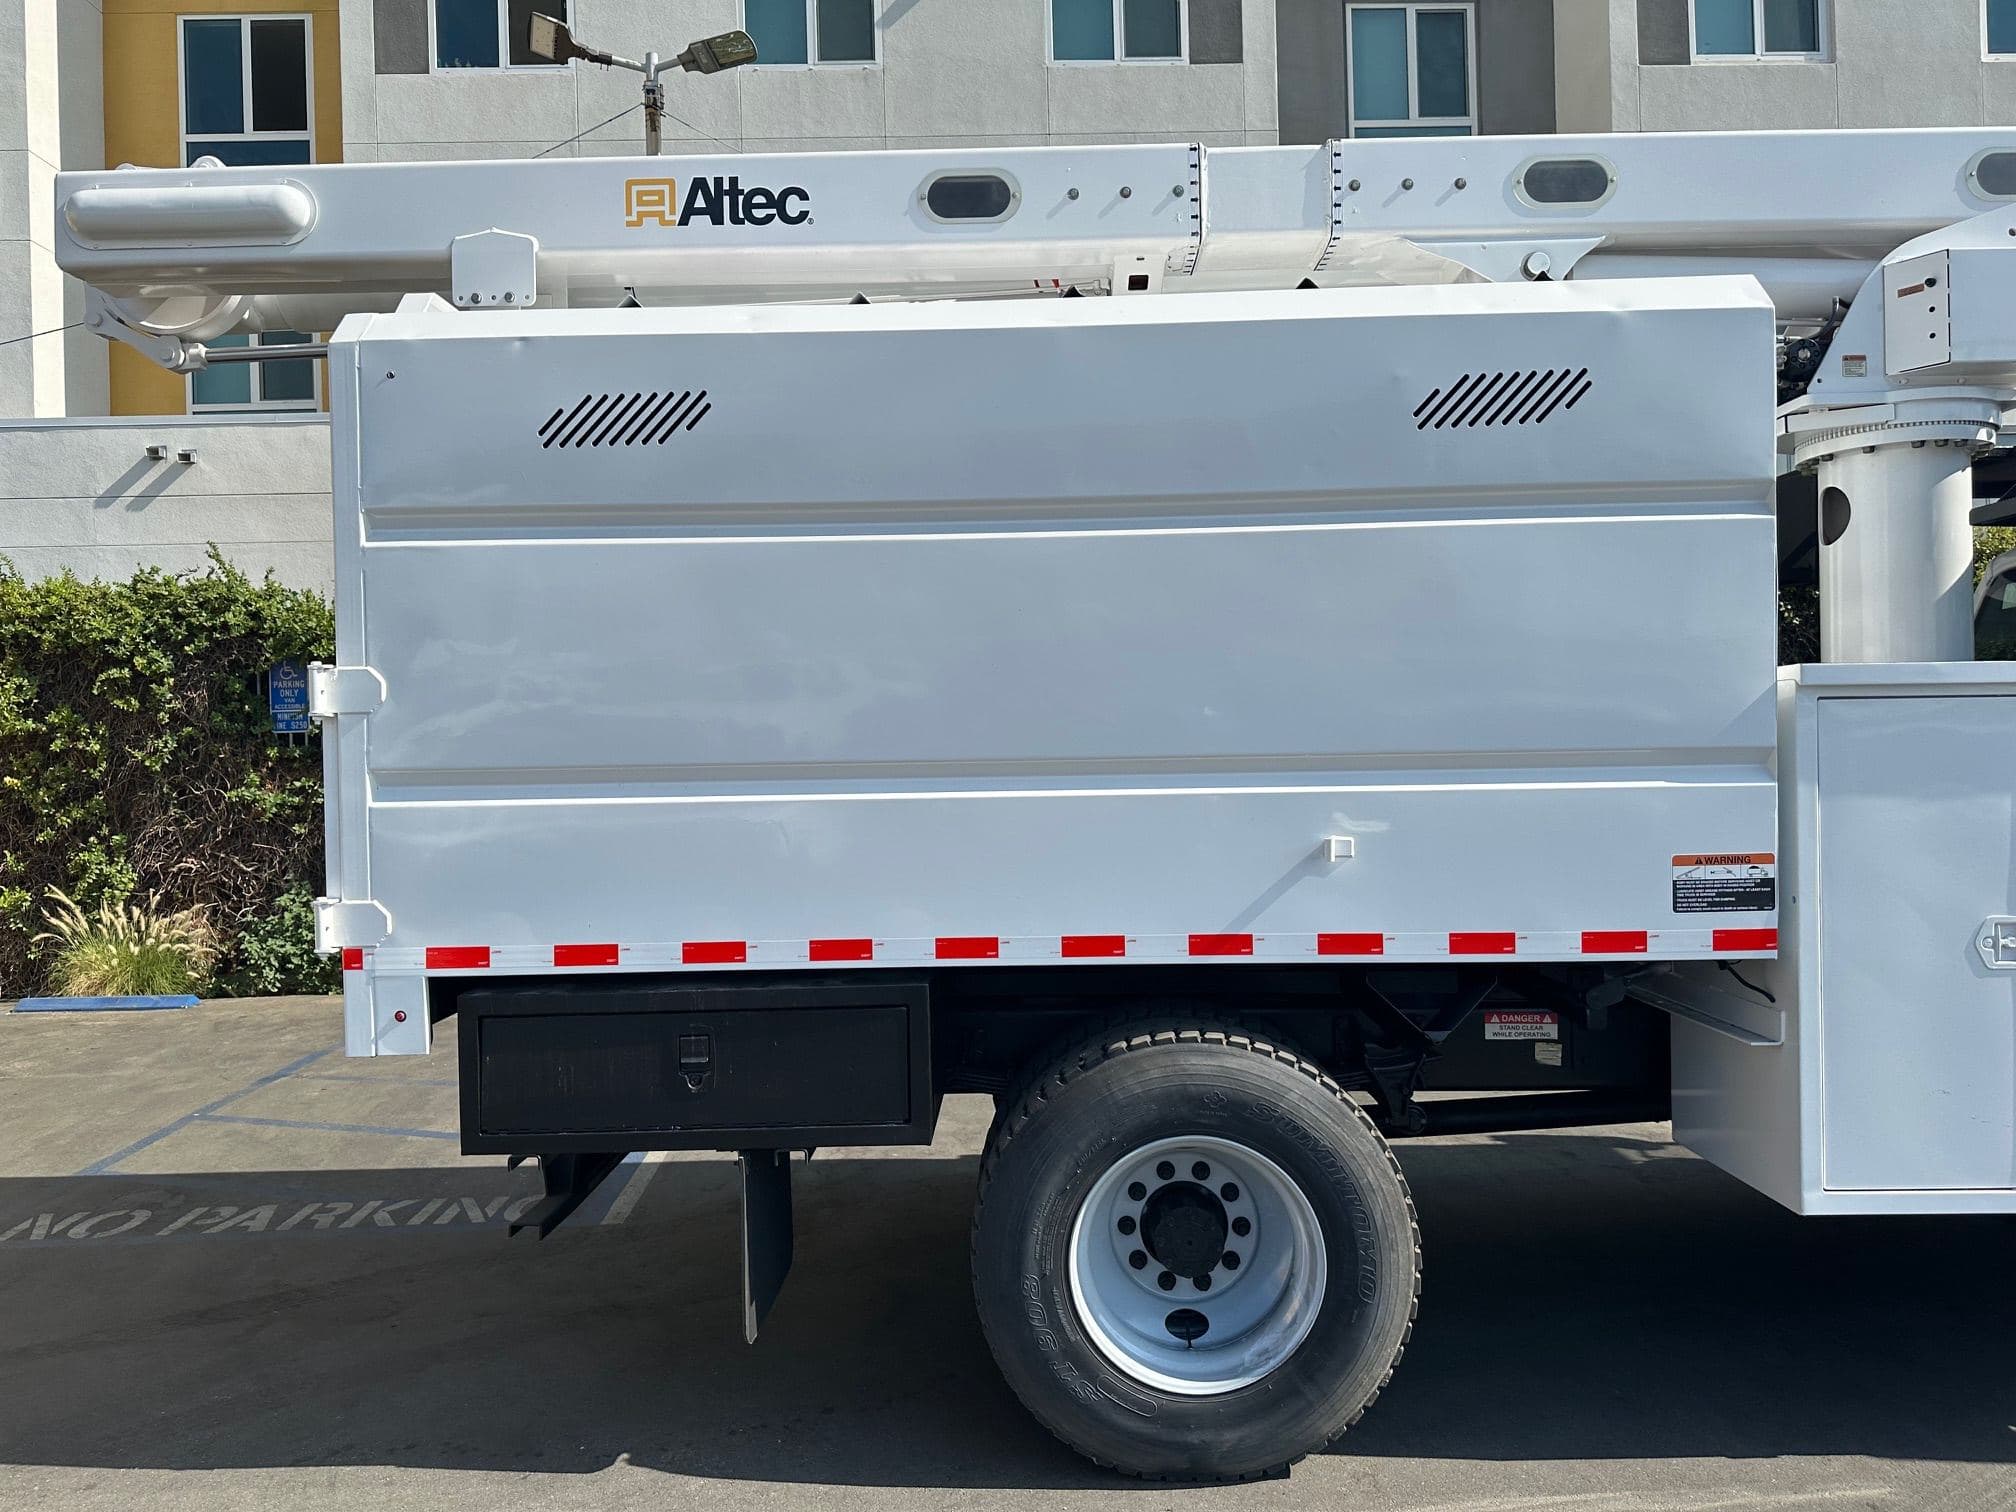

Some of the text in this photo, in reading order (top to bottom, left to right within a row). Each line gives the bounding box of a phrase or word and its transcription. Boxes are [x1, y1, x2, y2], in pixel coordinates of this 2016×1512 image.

[677, 176, 810, 226] Altec
[273, 680, 305, 689] PARKING
[280, 689, 299, 697] ONLY
[275, 721, 308, 730] INE $250
[1705, 855, 1751, 865] WARNING
[1501, 1014, 1541, 1023] DANGER
[0, 1209, 152, 1241] NO
